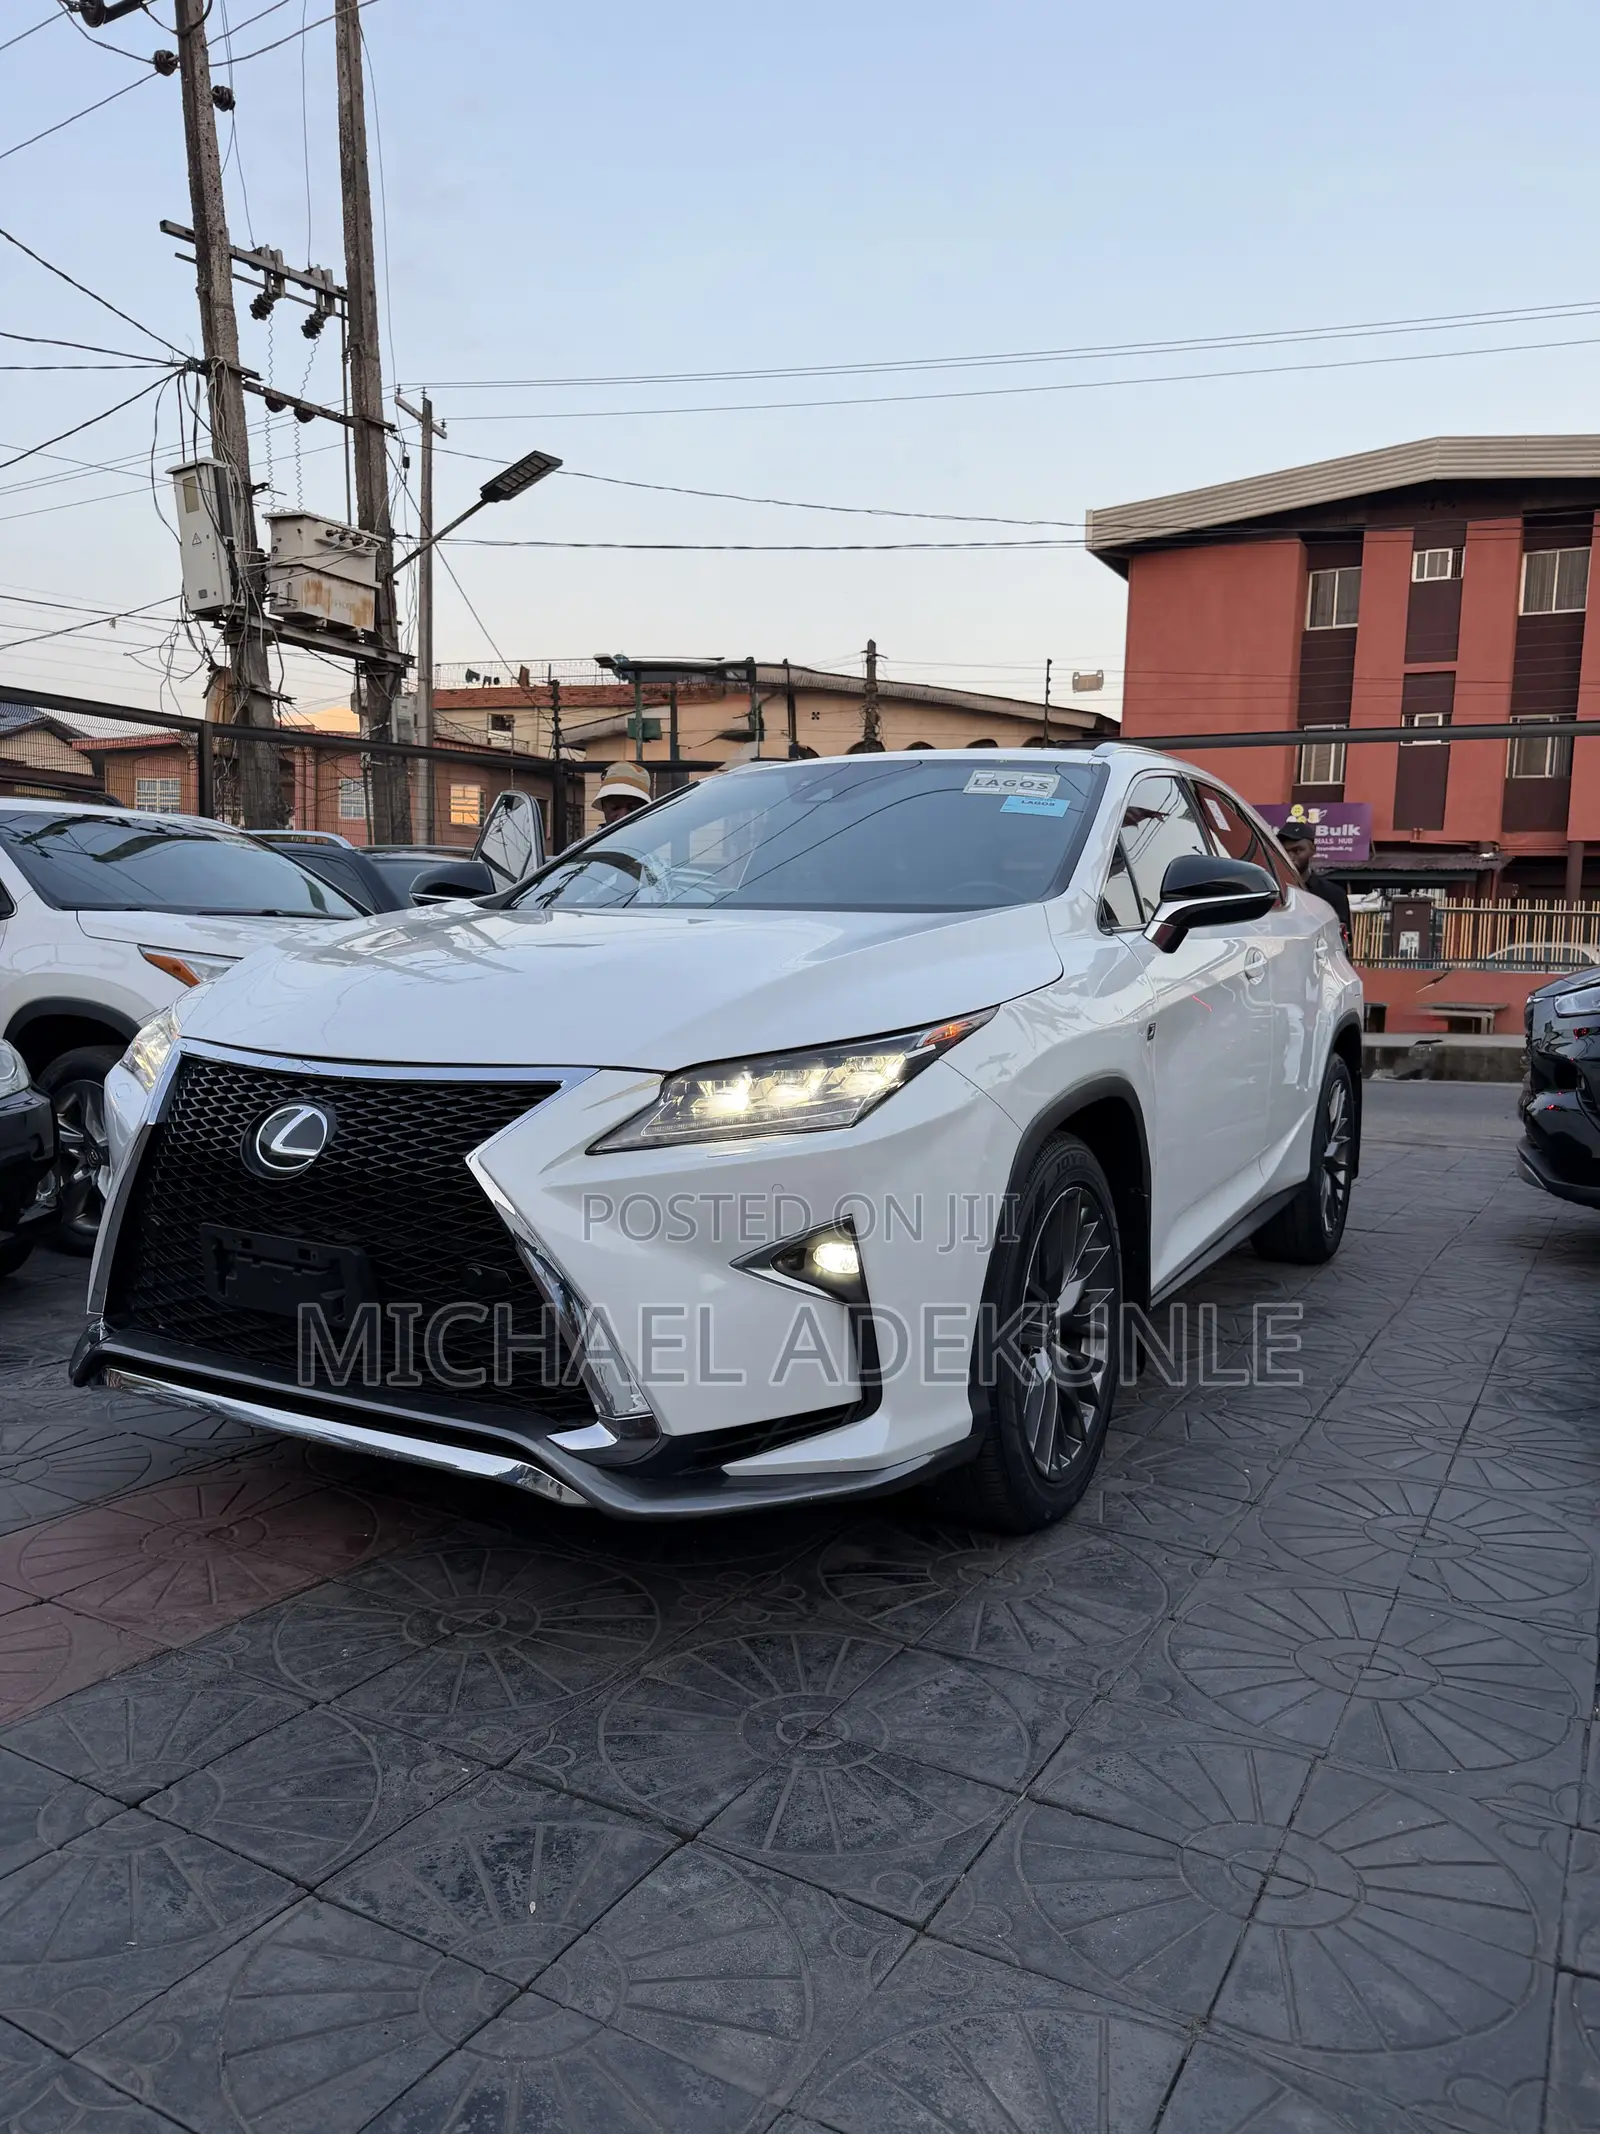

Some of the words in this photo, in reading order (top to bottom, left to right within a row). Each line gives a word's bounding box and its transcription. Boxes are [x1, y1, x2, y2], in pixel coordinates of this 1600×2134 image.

[973, 778, 1049, 790] LAGOS
[1021, 799, 1055, 807] LAGOS
[1315, 824, 1360, 836] Bulk
